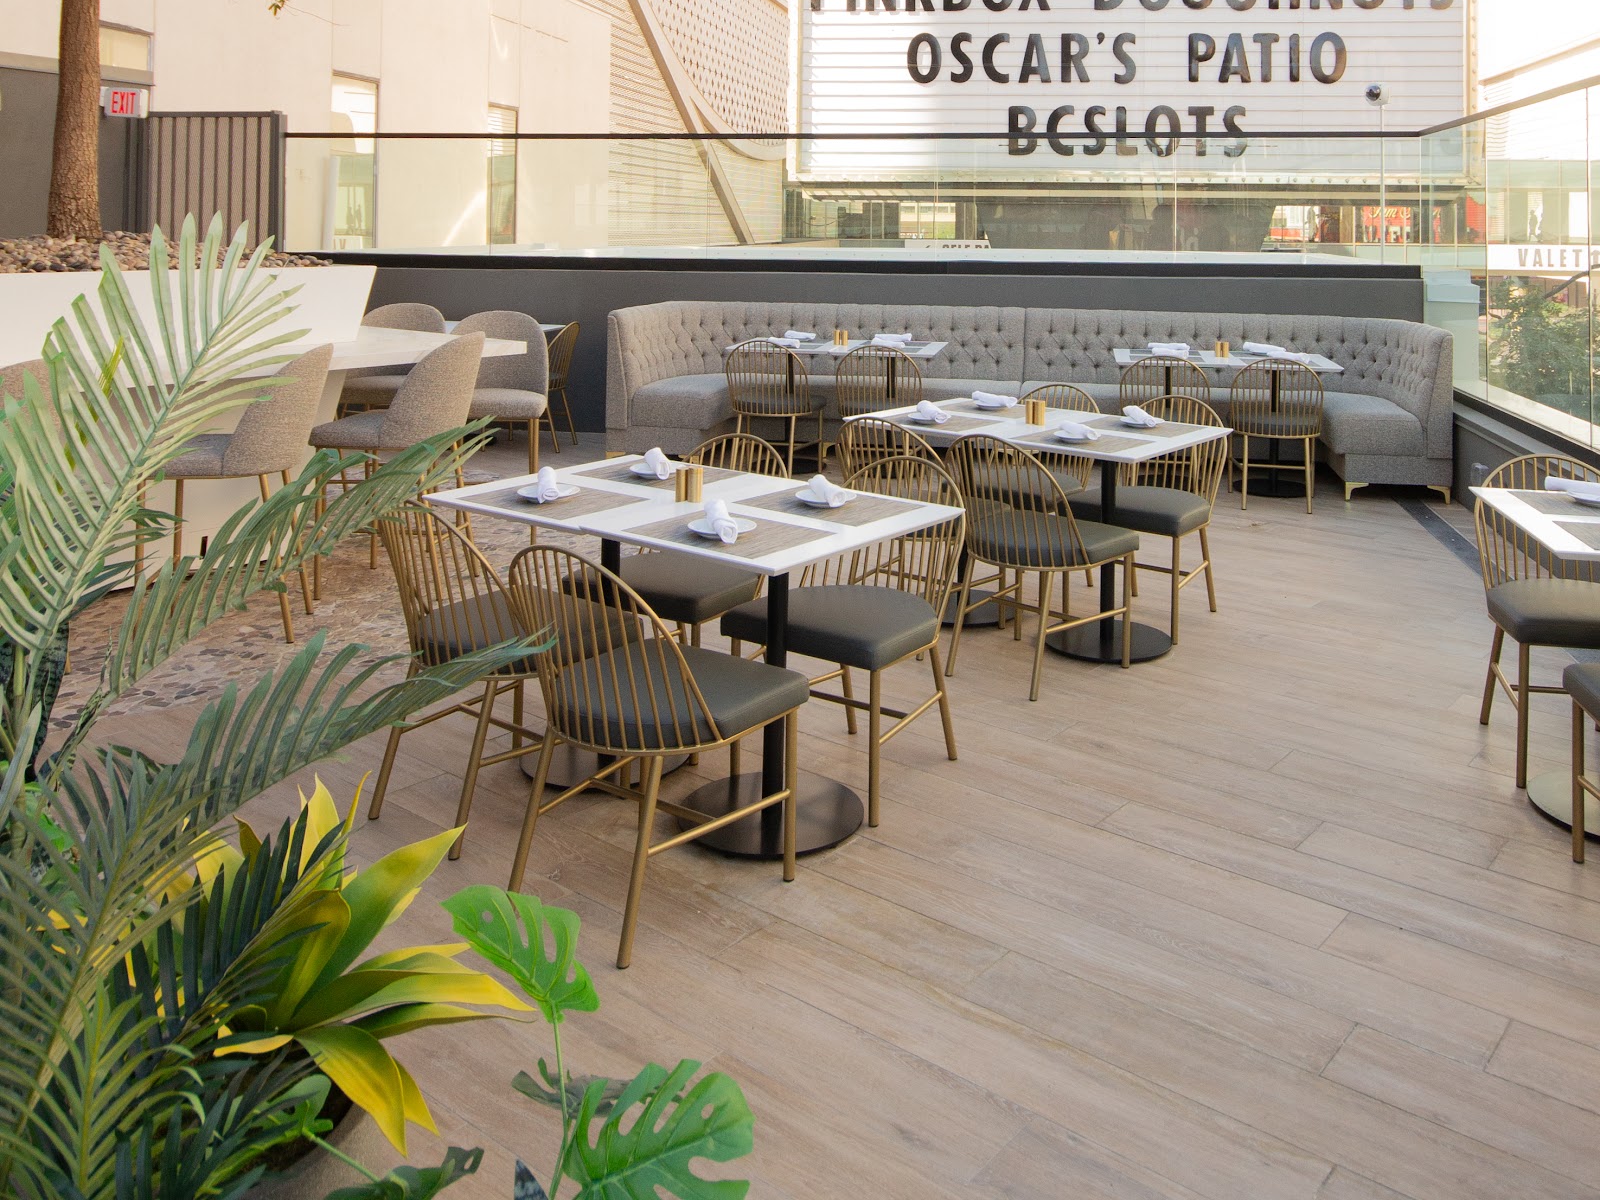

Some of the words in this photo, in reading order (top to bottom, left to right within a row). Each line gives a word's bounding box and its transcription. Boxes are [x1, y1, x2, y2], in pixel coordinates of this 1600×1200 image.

[907, 31, 1137, 84] OSCAR'S
[1188, 31, 1347, 85] PATIO
[111, 91, 136, 115] EXIT
[1008, 104, 1248, 158] BCSLOTS
[1517, 248, 1583, 268] VALET
